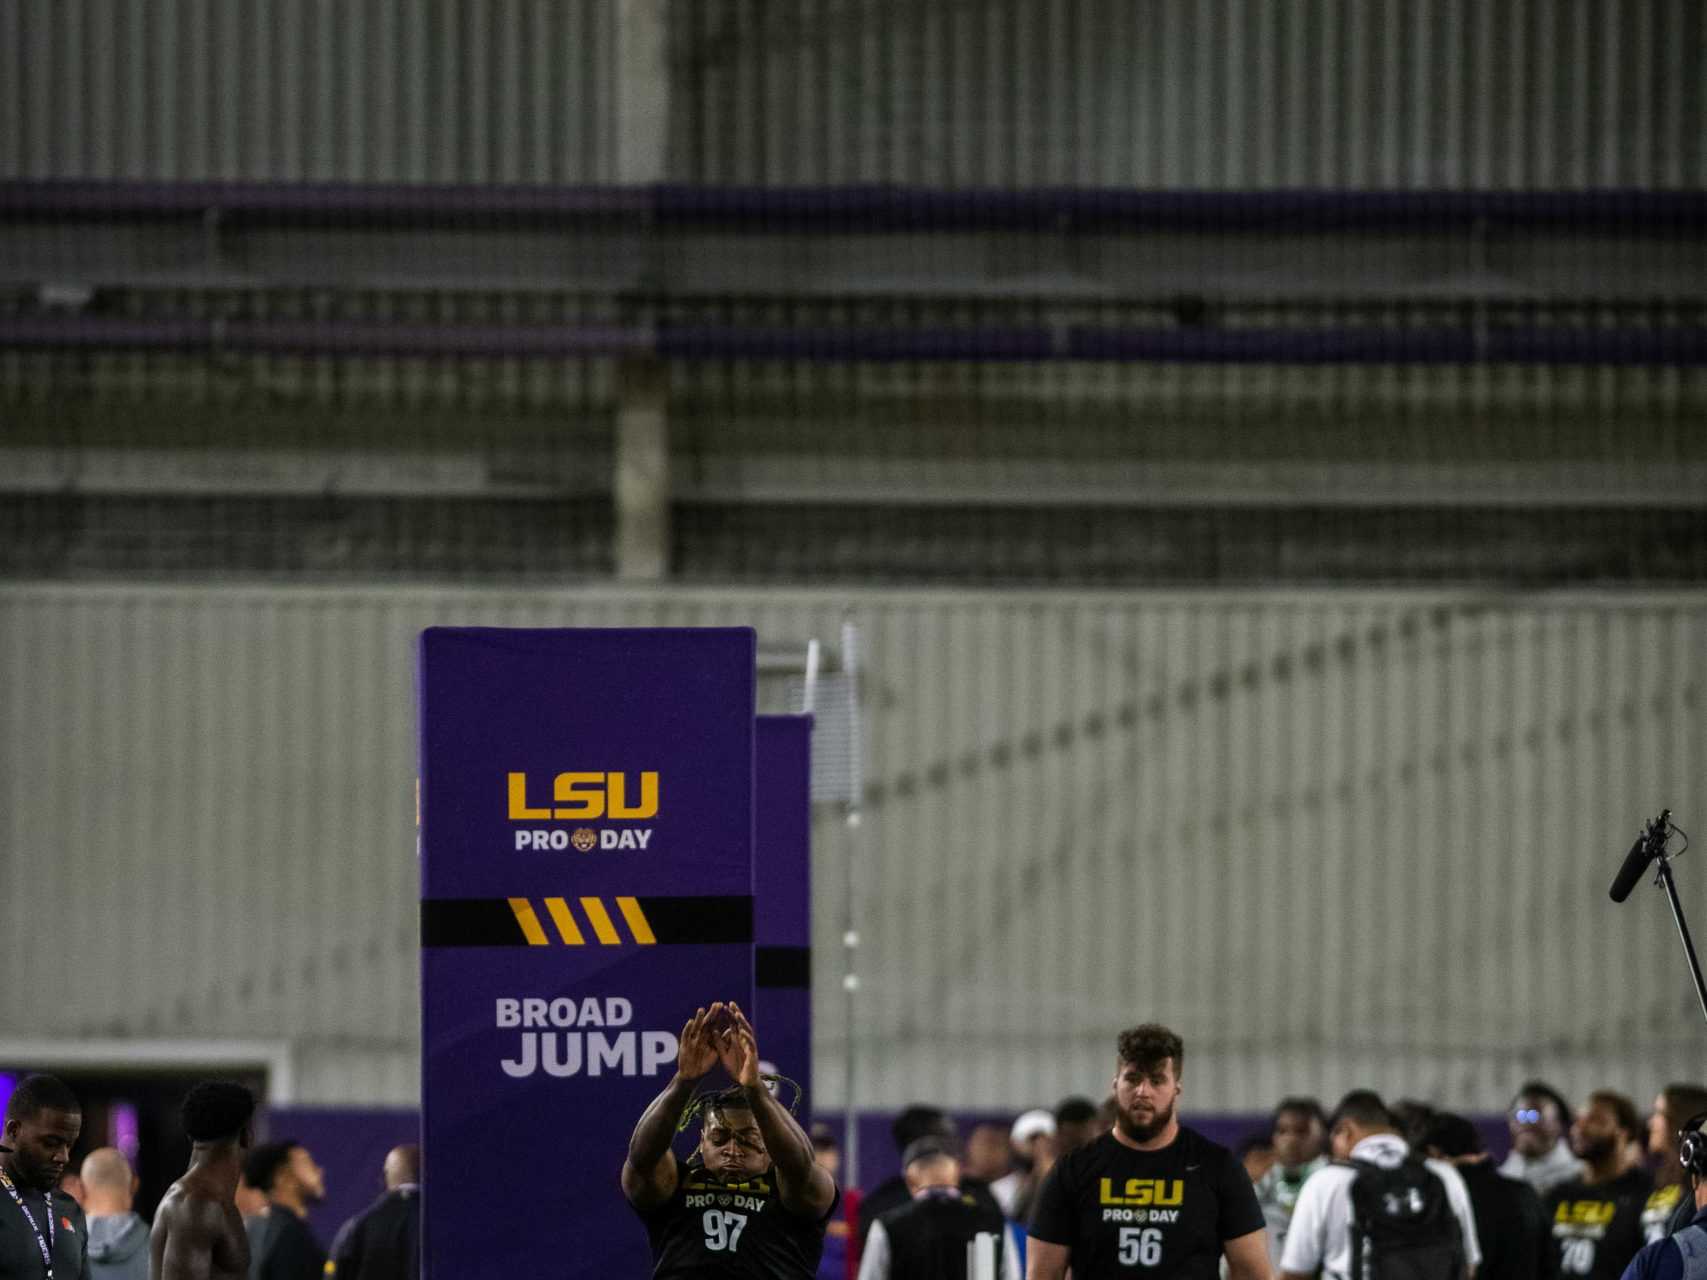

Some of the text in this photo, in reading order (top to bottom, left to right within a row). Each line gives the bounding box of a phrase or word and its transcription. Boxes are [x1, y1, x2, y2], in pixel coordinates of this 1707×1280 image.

[508, 771, 658, 819] LSU
[515, 829, 652, 850] PRO DAY
[496, 997, 632, 1027] BROAD
[501, 1031, 680, 1078] JUMP
[685, 1193, 766, 1212] PRO DAY
[1100, 1177, 1184, 1206] LSU
[702, 1208, 748, 1252] 97
[1102, 1208, 1179, 1223] PRO DAY
[1118, 1227, 1163, 1267] 56
